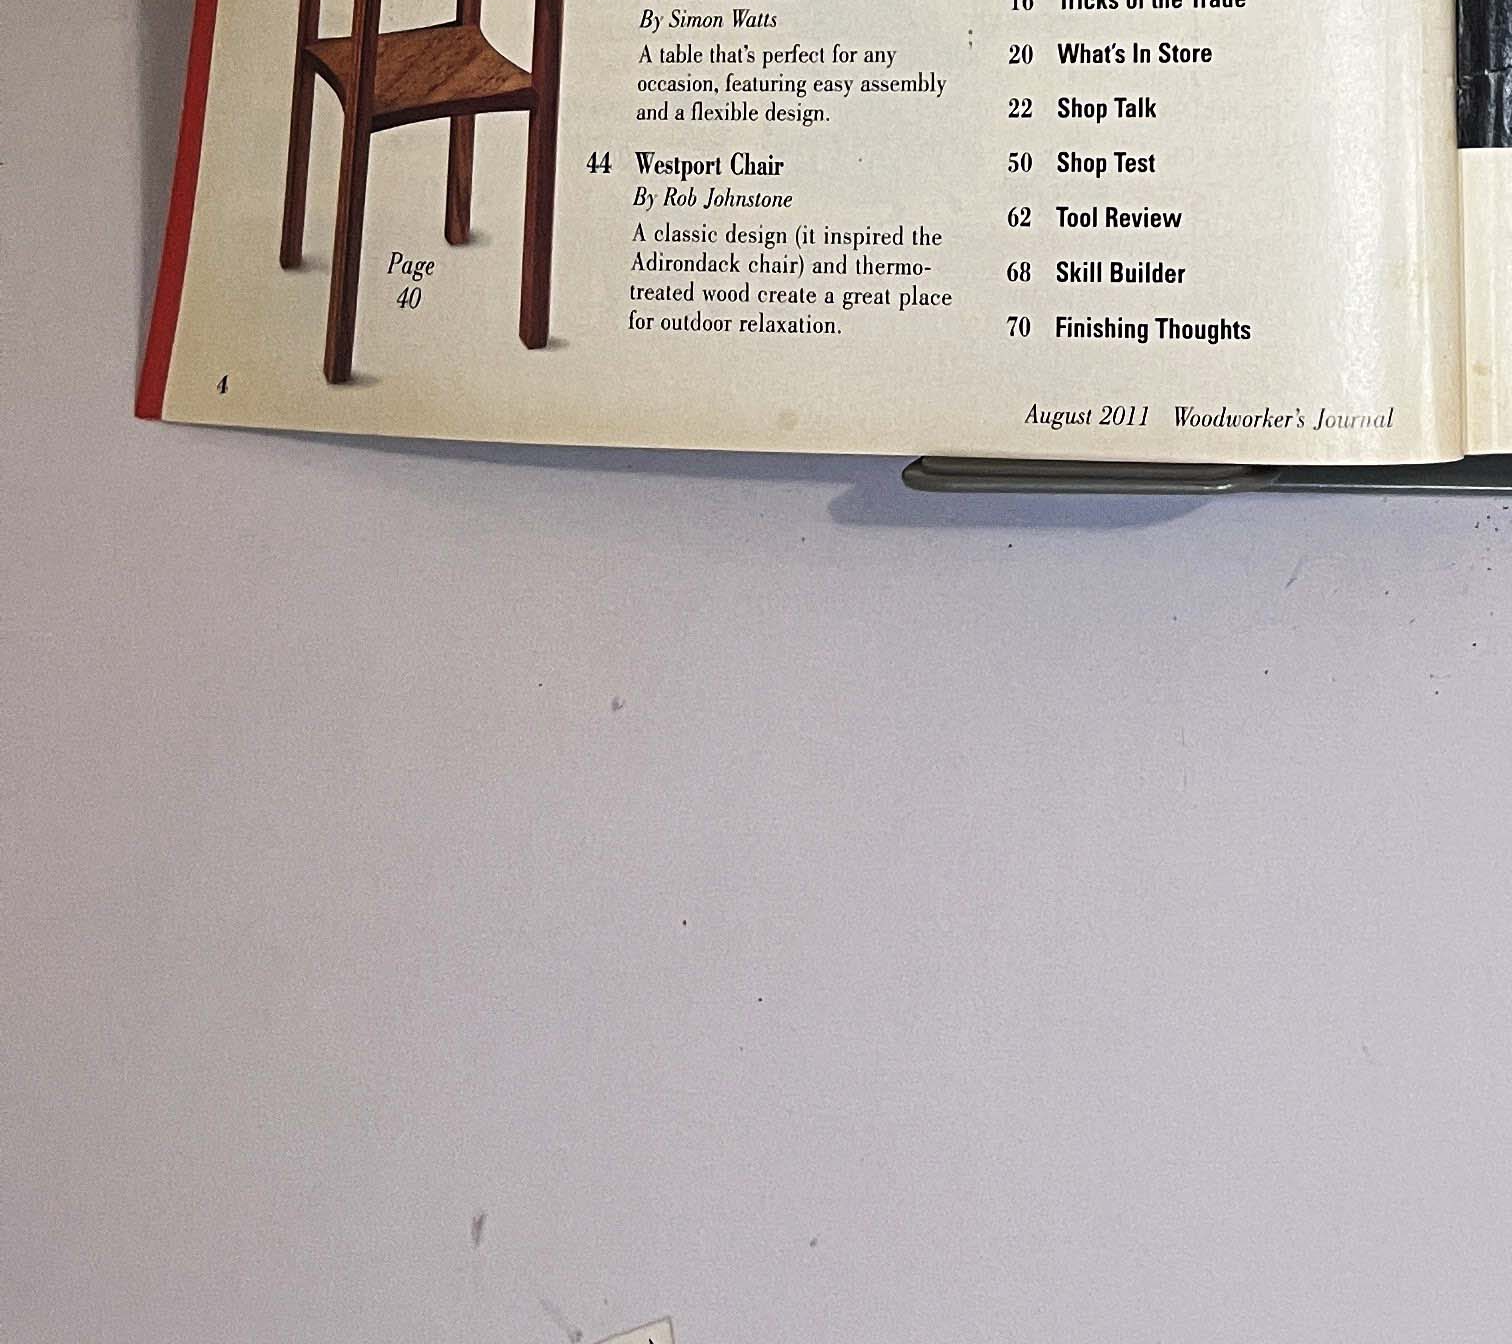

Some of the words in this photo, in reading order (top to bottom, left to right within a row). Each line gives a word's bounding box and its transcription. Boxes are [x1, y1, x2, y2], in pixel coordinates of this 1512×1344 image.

[639, 8, 661, 34] By
[668, 8, 723, 29] Simon
[732, 8, 777, 28] Watts
[1008, 43, 1034, 65] 20
[1057, 42, 1126, 64] What's
[1133, 42, 1151, 64] In
[1158, 42, 1213, 64] Store
[1008, 97, 1033, 119] 22
[1057, 96, 1108, 124] Shop
[1113, 96, 1157, 118] Talk
[586, 151, 612, 174] 44
[634, 151, 722, 182] Westport
[730, 151, 785, 176] Chair
[1007, 151, 1033, 173] 50
[1057, 151, 1107, 179] Shop
[1113, 151, 1156, 173] Test
[632, 186, 654, 212] By
[663, 186, 697, 207] Rob
[702, 187, 793, 210] Johnstone
[1007, 206, 1032, 228] 62
[1055, 206, 1098, 228] Tool
[1105, 206, 1183, 228] Review
[386, 251, 435, 282] Page
[1006, 261, 1031, 282] 68
[1056, 260, 1102, 283] Skill
[1110, 261, 1186, 284] Builder
[396, 286, 422, 310] 40
[1006, 315, 1031, 338] 70
[1055, 316, 1149, 344] Finishing
[1154, 317, 1251, 345] Thoughts
[216, 374, 229, 395] 4
[1024, 403, 1092, 431] August
[1098, 405, 1149, 426] 2011
[1174, 406, 1305, 428] Woodworker's
[1312, 406, 1395, 431] Journal
